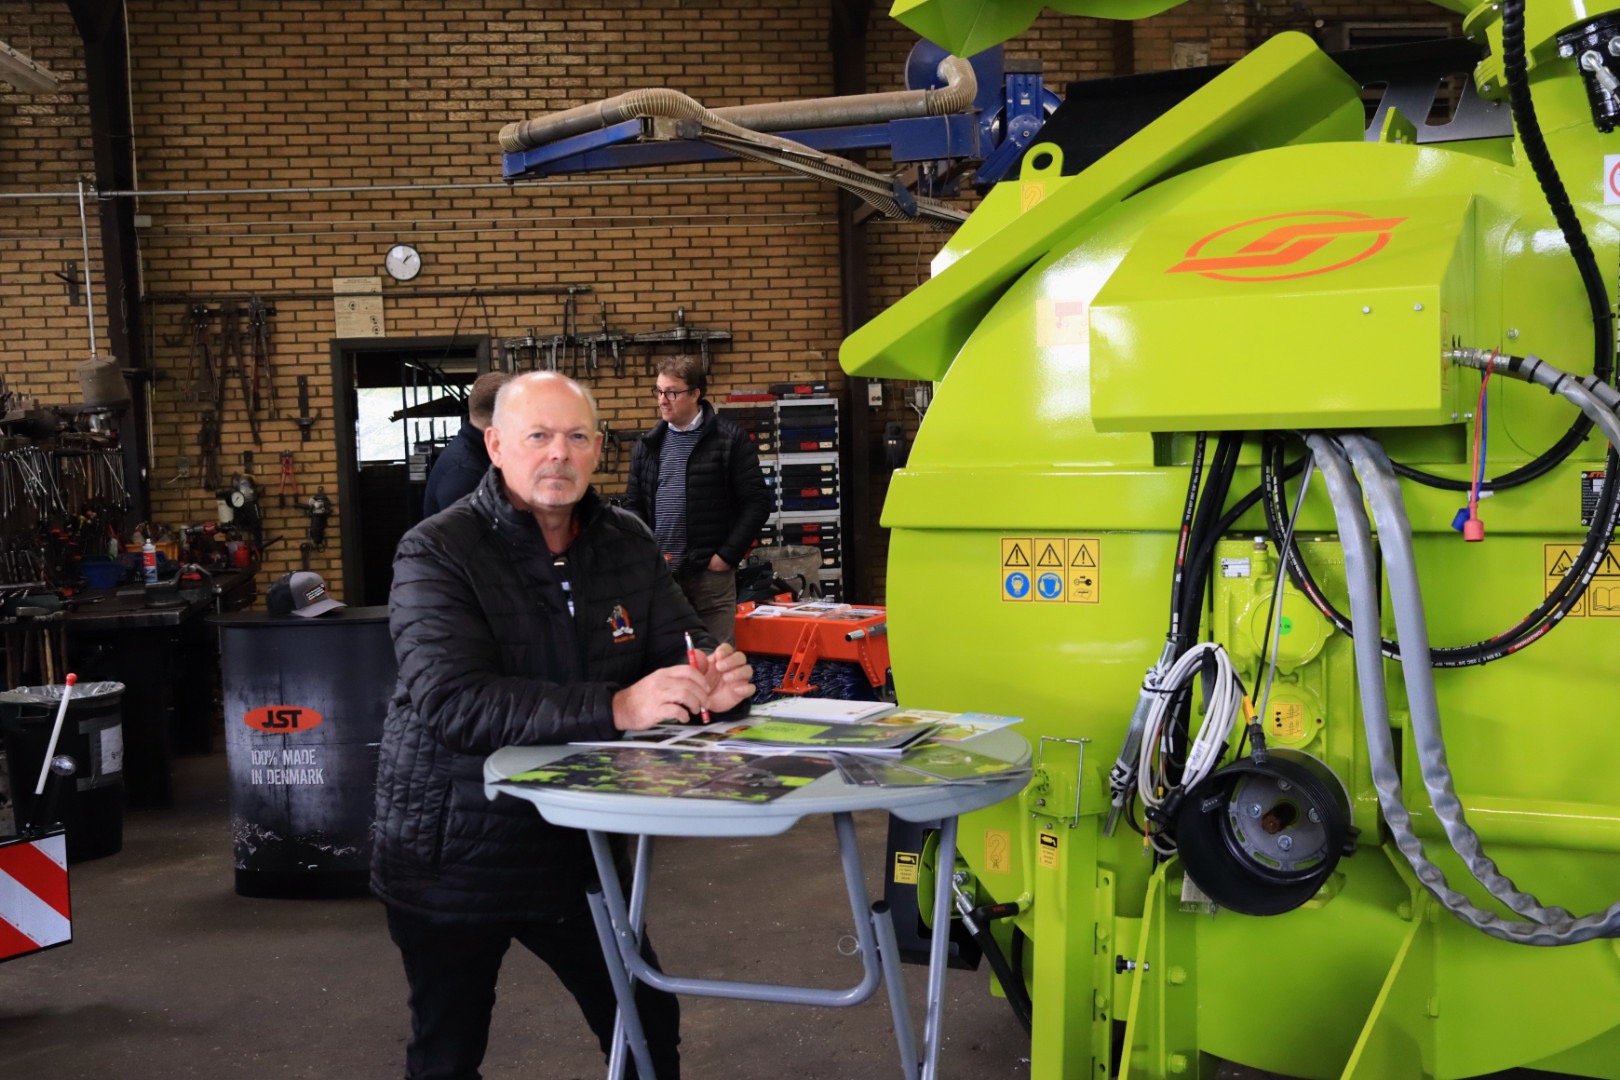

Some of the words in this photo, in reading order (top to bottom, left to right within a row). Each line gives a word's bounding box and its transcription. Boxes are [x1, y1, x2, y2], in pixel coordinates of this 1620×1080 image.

[262, 710, 302, 728] JST
[251, 749, 278, 766] 100%
[282, 749, 316, 765] MADE
[251, 769, 263, 785] IN
[266, 768, 325, 785] DENMARK
